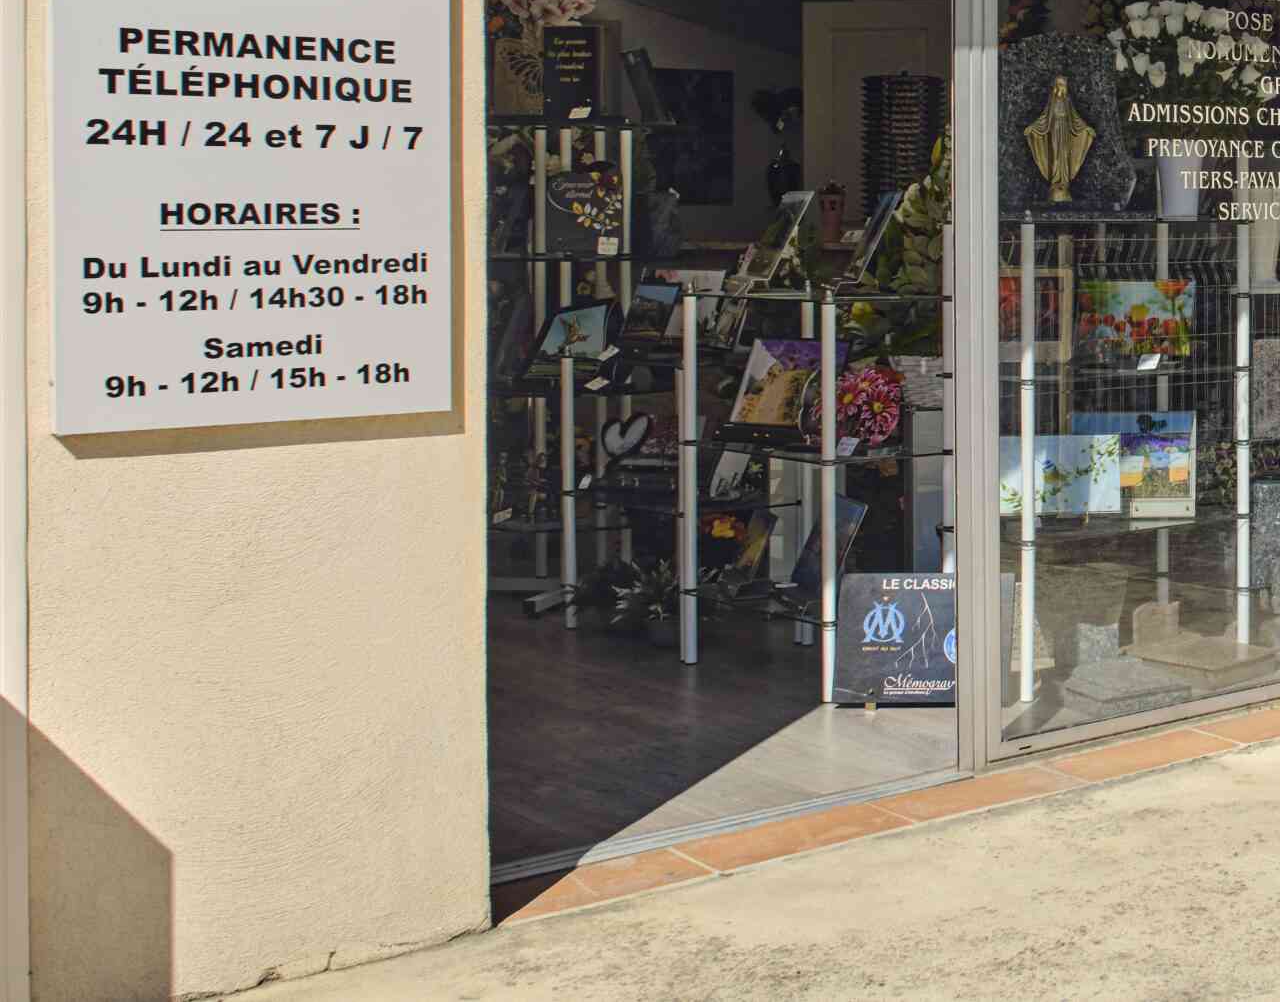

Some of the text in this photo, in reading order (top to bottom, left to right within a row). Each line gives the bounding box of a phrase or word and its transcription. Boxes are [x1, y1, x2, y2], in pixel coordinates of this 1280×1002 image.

[1225, 10, 1274, 33] POSE
[119, 27, 397, 65] PERMANENCE
[98, 63, 413, 104] TÉLÉPHONIQUE
[1128, 102, 1250, 125] ADMISSIONS
[85, 118, 424, 150] 24H / 24 et 7 J / 7
[1148, 137, 1265, 160] PREVOYANCE
[160, 202, 341, 226] HORAIRES
[82, 252, 429, 280] Du Lundi au Vendredi
[82, 291, 124, 314] 9h
[159, 289, 218, 312] 12h
[229, 288, 239, 311] /
[250, 286, 344, 310] 14h30
[374, 284, 428, 306] 18h
[203, 334, 324, 360] Samedi
[105, 375, 147, 399] 9h
[181, 370, 240, 395] 12h
[250, 369, 260, 392] /
[270, 367, 326, 390] 15h
[357, 363, 411, 385] 18h
[883, 579, 900, 590] LE
